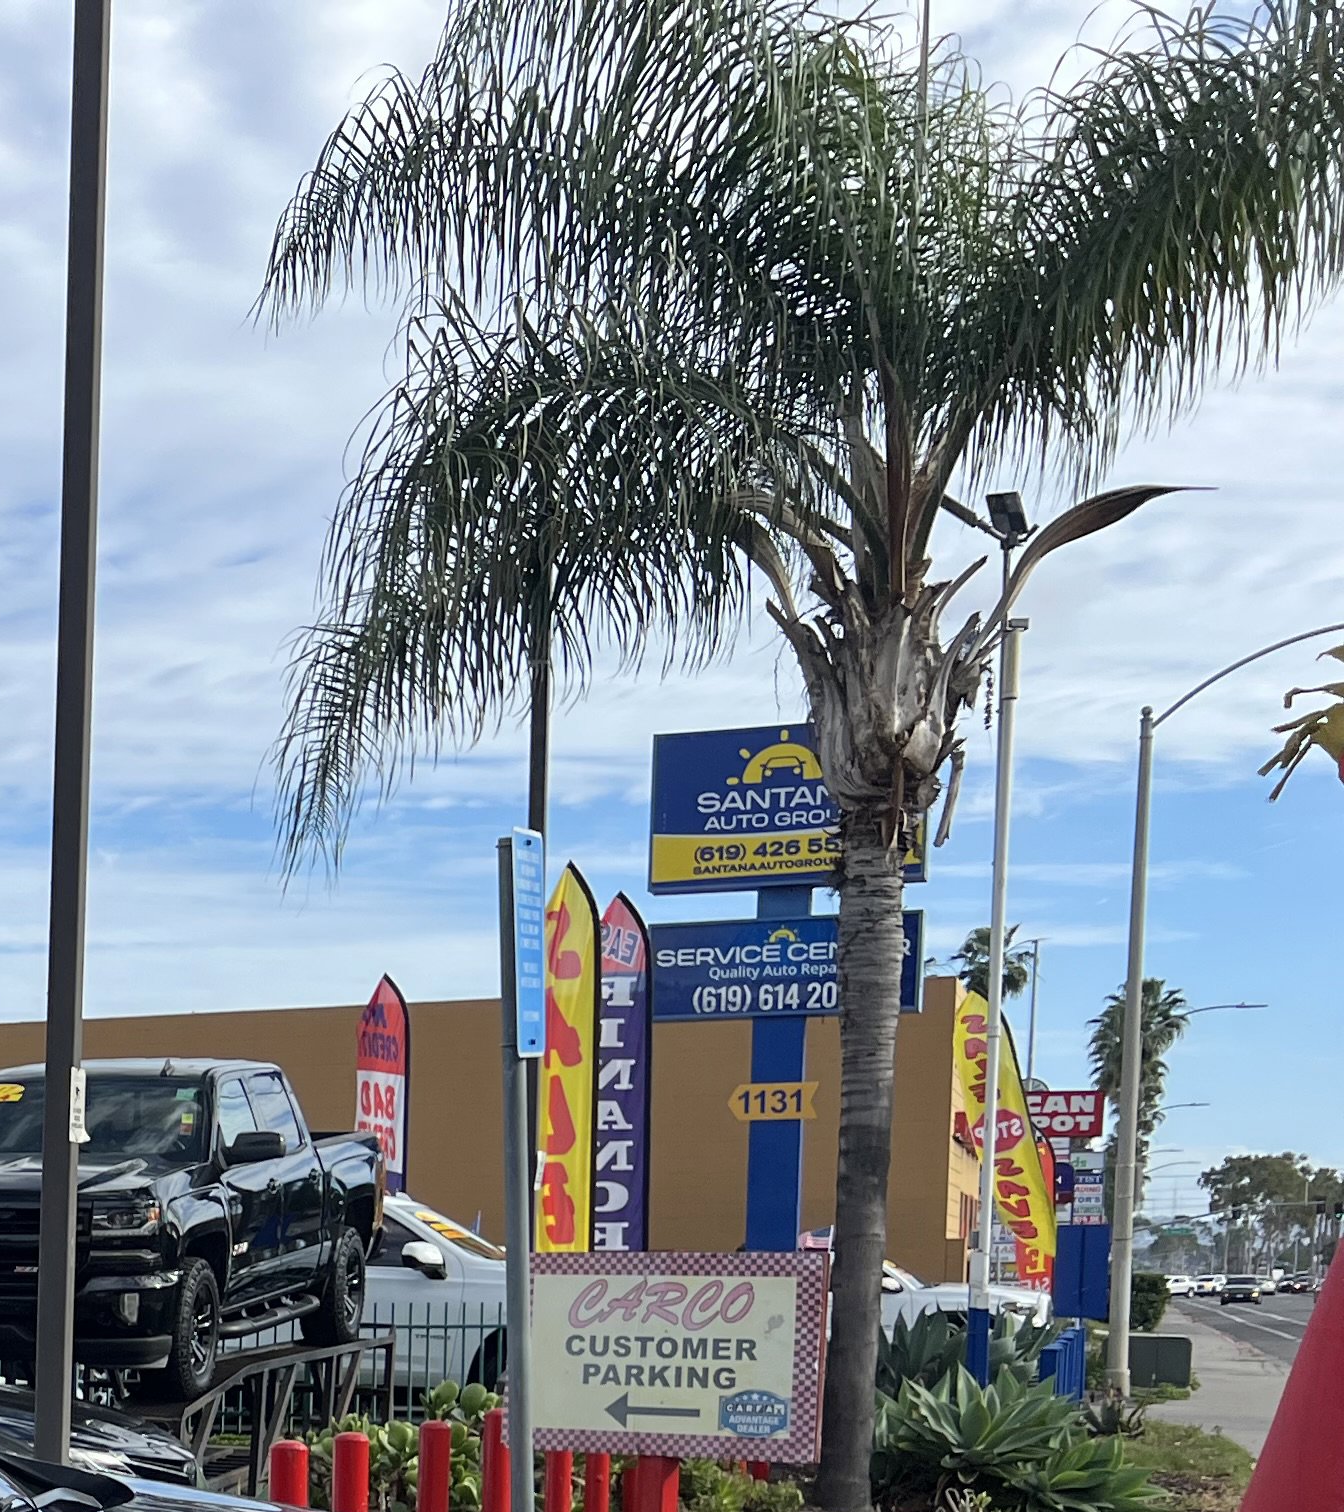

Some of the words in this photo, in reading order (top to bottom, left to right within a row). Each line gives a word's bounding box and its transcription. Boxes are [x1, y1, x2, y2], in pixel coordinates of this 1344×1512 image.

[704, 813, 769, 831] AUTO
[694, 843, 746, 864] (619)
[753, 839, 800, 858] 426
[656, 944, 781, 967] SERVICE
[709, 967, 760, 980] Quality
[763, 965, 797, 977] Auto
[692, 985, 752, 1013] (619)
[758, 983, 800, 1010] 614
[738, 1088, 803, 1114] 1131
[568, 1278, 755, 1331] CARCO
[565, 1334, 758, 1361] CUSTOMER
[582, 1363, 736, 1389] PARKING
[728, 1414, 780, 1426] ADVANTAGE
[736, 1424, 771, 1434] DEALER
